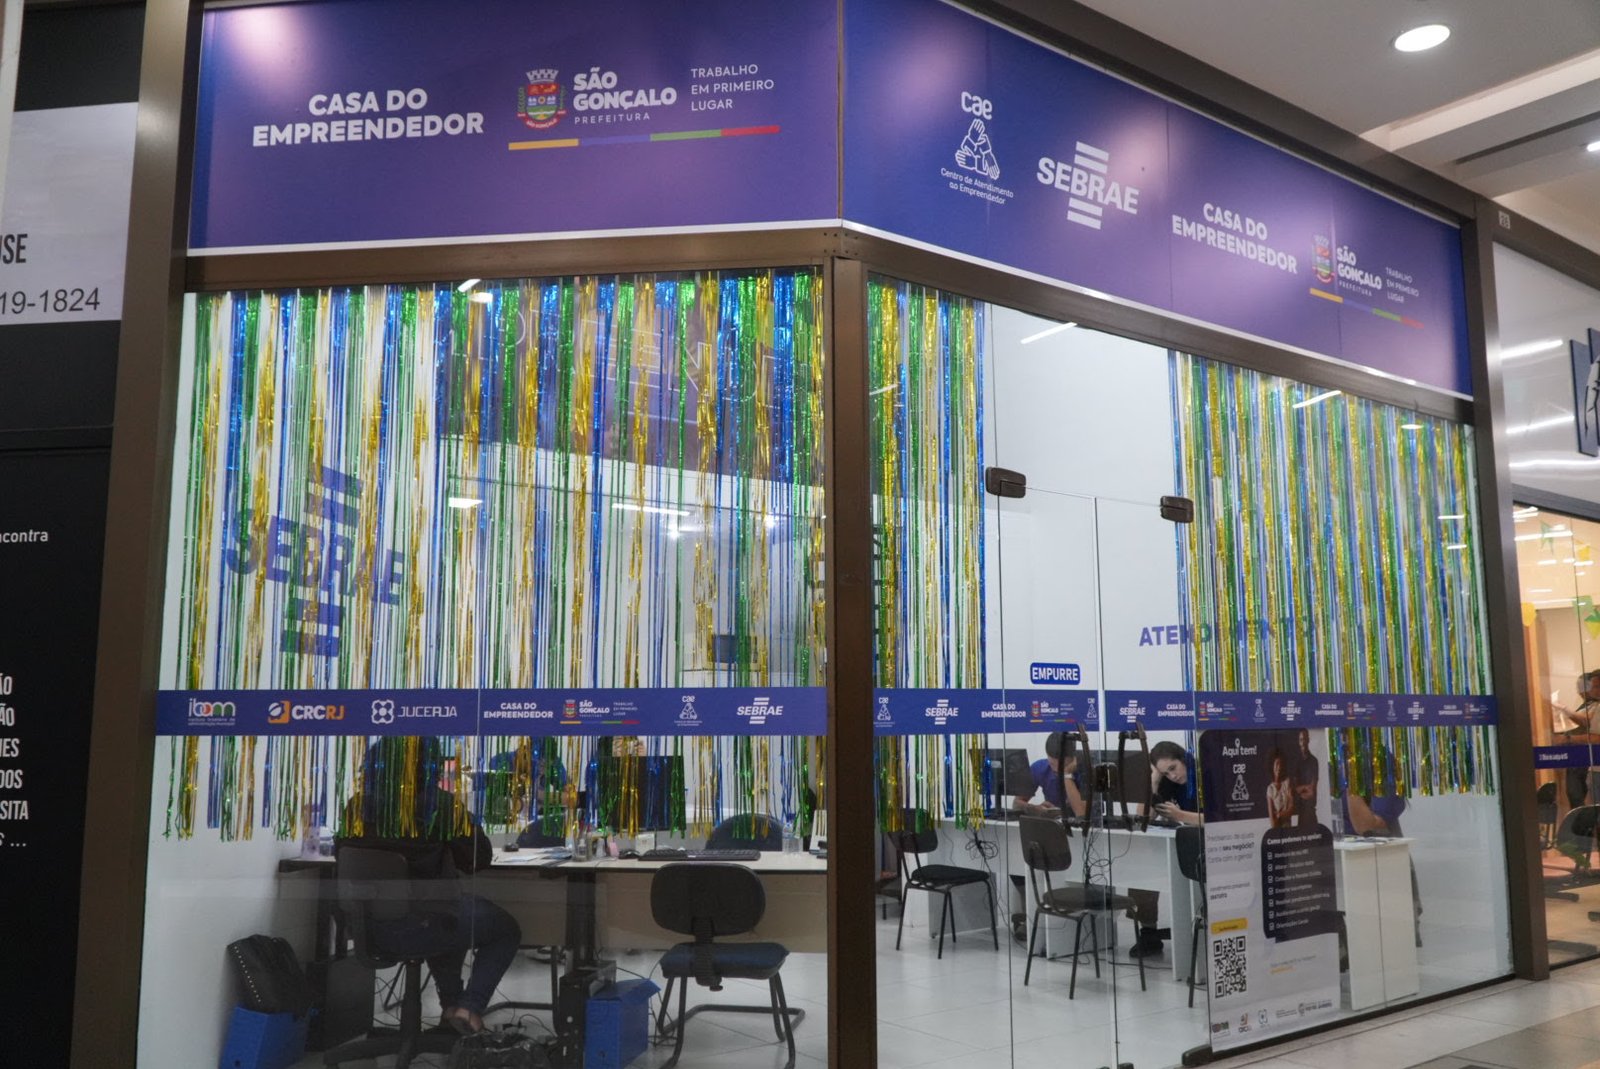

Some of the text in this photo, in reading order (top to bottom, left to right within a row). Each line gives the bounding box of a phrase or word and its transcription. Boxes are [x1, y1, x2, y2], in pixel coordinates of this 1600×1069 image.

[573, 67, 618, 91] SÃO
[690, 64, 759, 79] TRABALHO
[691, 79, 775, 95] EM PRIMEIRO
[308, 88, 428, 116] CASA DO
[573, 87, 677, 111] GONÇALO
[691, 98, 734, 111] LUGAR
[960, 91, 993, 120] cae
[574, 112, 651, 125] PREFEITURA
[252, 112, 484, 147] EMPREENDEDOR
[940, 167, 1014, 198] Centro de Atendimento
[1036, 157, 1140, 215] SEBRAE
[949, 182, 1006, 204] ao Empreendedor
[1203, 202, 1268, 240] CASA DO
[0, 233, 28, 265] SE
[1171, 214, 1298, 275] EMPREENDEDOR
[1337, 245, 1357, 266] SÃO
[1337, 263, 1382, 290] GONÇALO
[0, 529, 49, 543] contra
[1032, 666, 1079, 681] EMPURRE
[398, 706, 458, 718] JUCERJA
[500, 702, 537, 710] CASA DO
[579, 700, 593, 708] SÃO
[736, 705, 784, 716] SEBRAE
[925, 707, 959, 717] SEBRAE
[992, 703, 1007, 711] CASA
[1119, 707, 1146, 716] SEBRAE
[291, 705, 345, 721] CRCRJ
[483, 710, 554, 719] EMPREENDEDOR
[981, 710, 1027, 719] EMPREENDEDOR
[0, 737, 20, 758] ES
[1222, 745, 1257, 758] Aqui tem!
